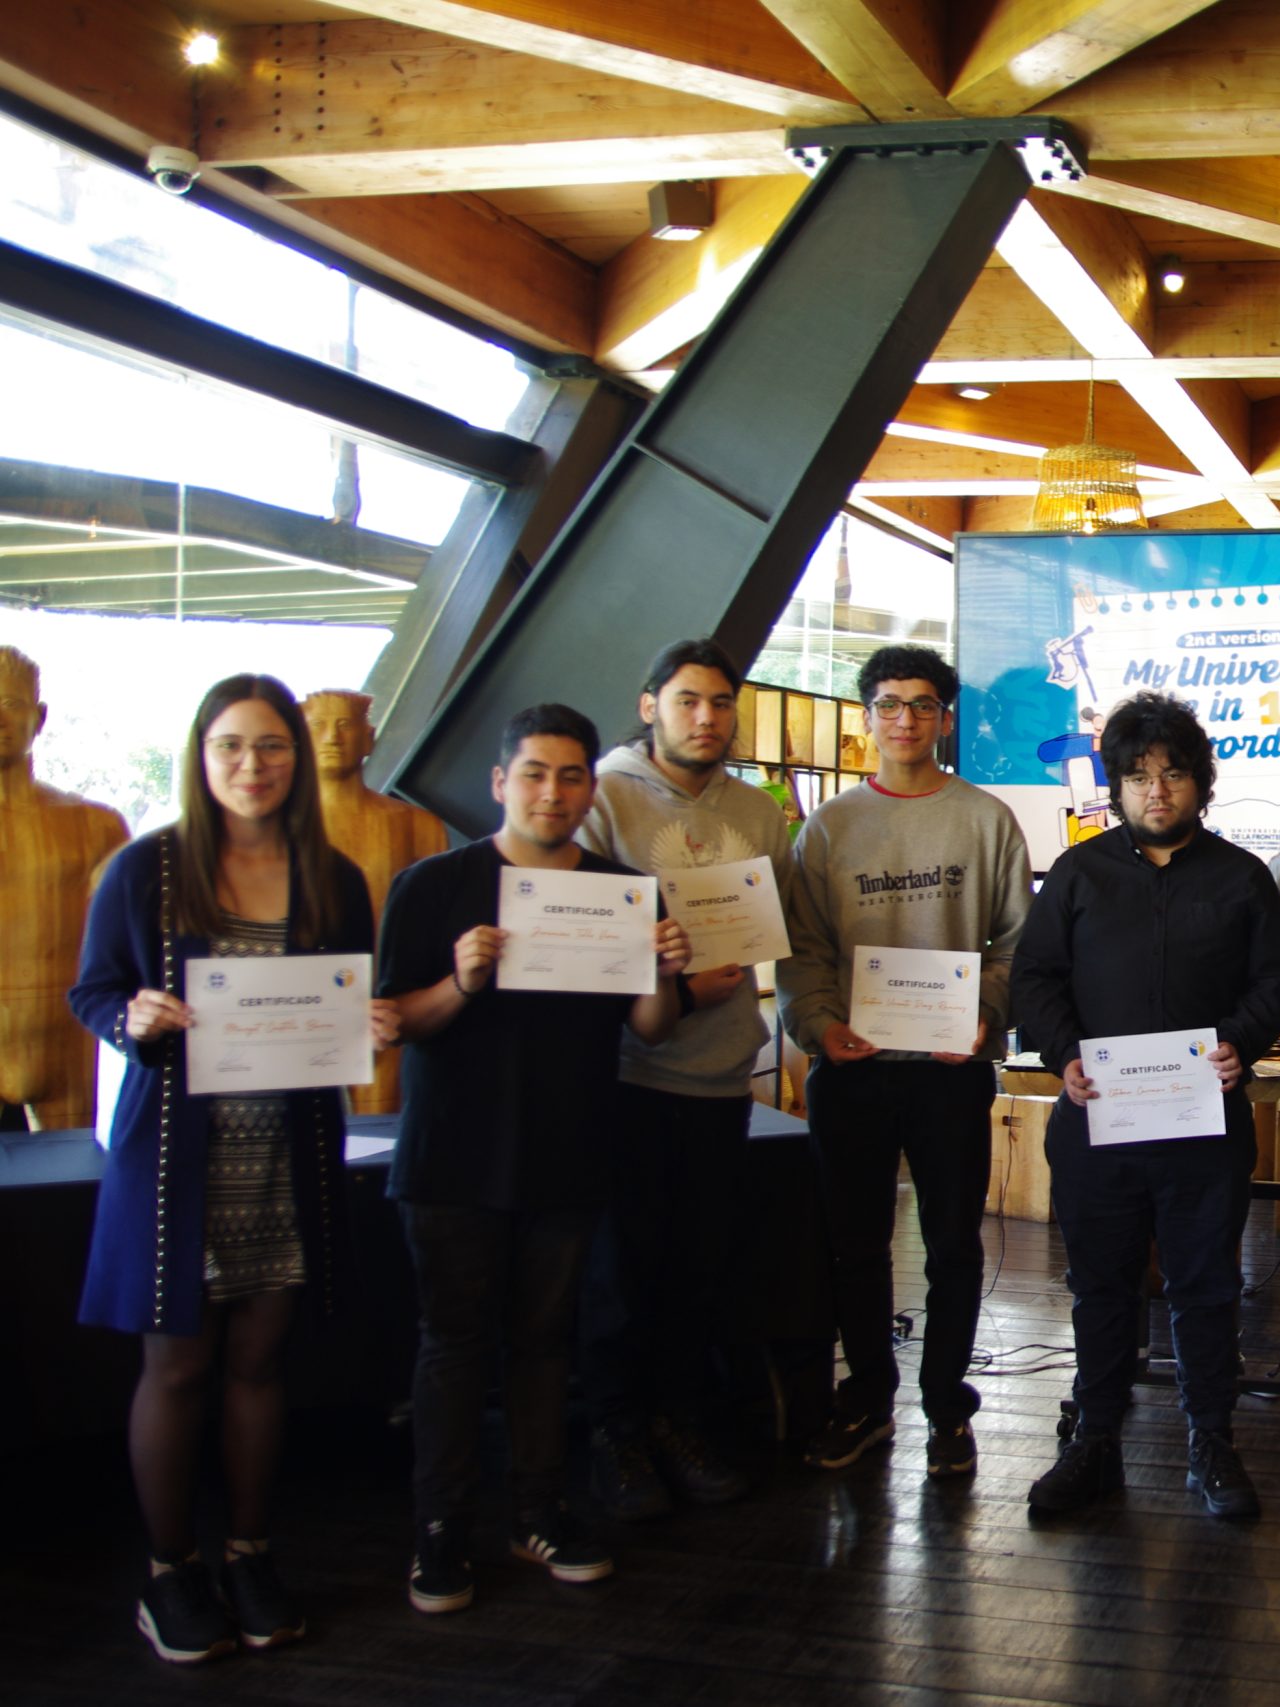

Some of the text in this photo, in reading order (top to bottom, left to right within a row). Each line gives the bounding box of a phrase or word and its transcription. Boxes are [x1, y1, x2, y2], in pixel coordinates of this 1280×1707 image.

[1184, 632, 1216, 647] 2nd
[1123, 658, 1176, 687] My
[1209, 690, 1244, 722] in
[856, 865, 941, 895] Timberland
[687, 895, 740, 907] CERTIFICADO
[544, 905, 615, 917] CERTIFICADO
[888, 979, 945, 990] CERTIFICADO
[238, 995, 322, 1007] CERTIFICADO
[1120, 1064, 1181, 1075] CERTIFICADO
